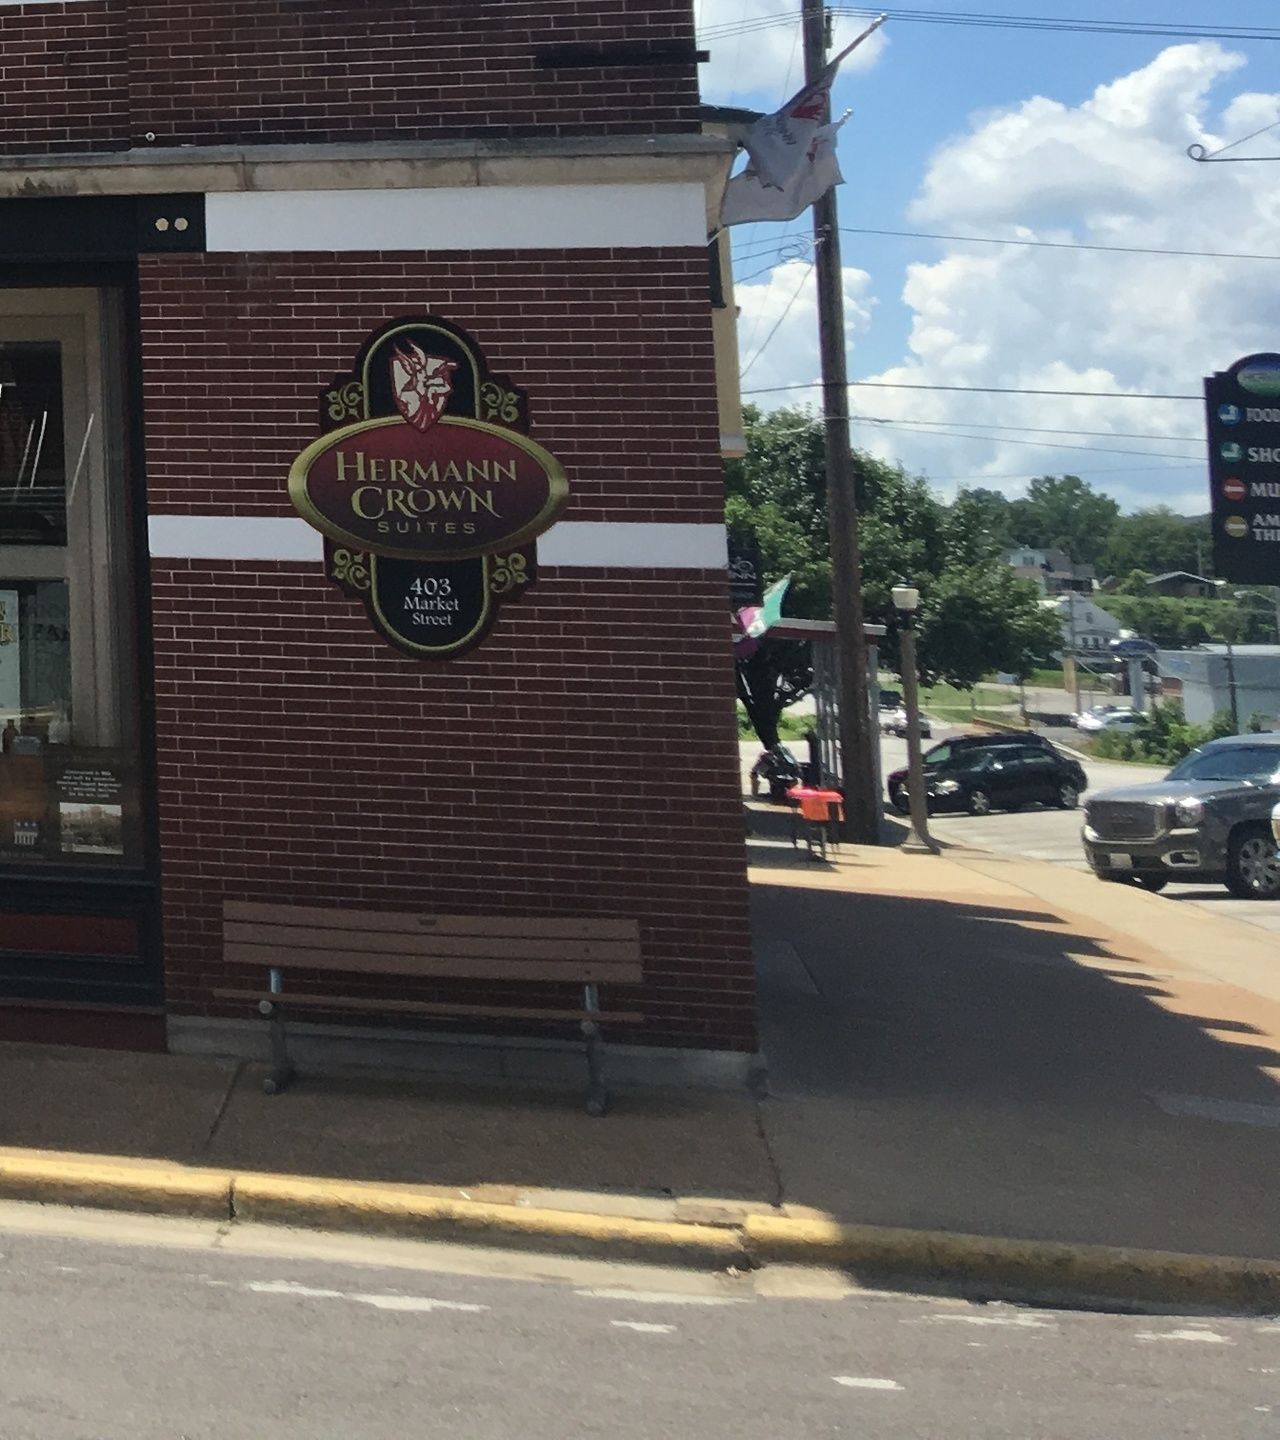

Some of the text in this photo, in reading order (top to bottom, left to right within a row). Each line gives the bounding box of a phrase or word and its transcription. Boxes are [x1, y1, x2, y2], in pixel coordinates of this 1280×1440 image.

[336, 451, 518, 488] HERMANN
[351, 486, 503, 520] CROWN
[377, 520, 477, 535] SUITES
[410, 577, 453, 596] 403
[403, 595, 460, 612] Market
[412, 612, 454, 627] Street
